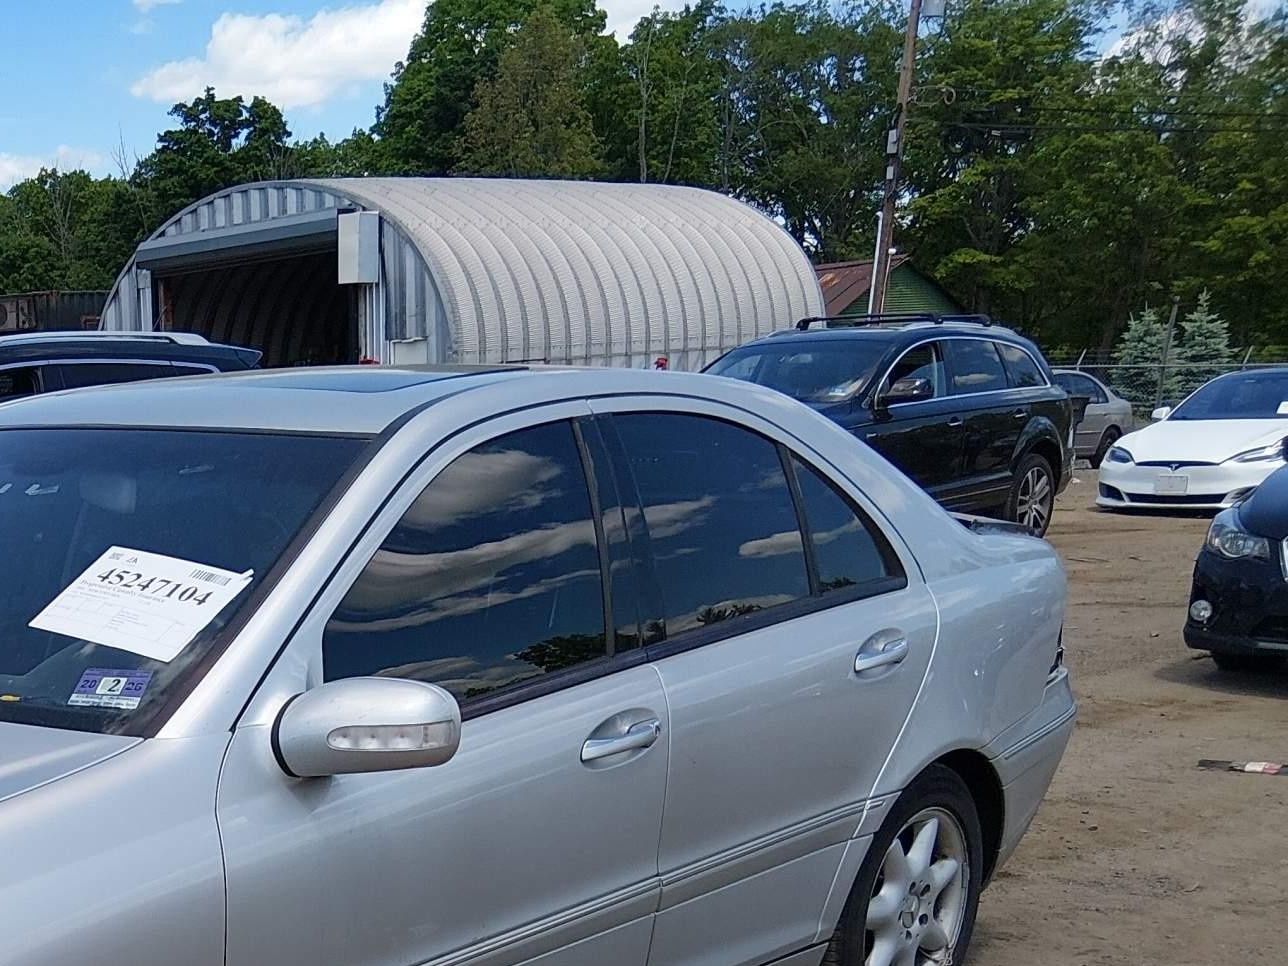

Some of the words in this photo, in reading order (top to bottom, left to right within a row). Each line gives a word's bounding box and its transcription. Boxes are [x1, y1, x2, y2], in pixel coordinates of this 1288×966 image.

[97, 568, 213, 606] 45247104
[81, 679, 97, 689] 20
[107, 678, 121, 692] 2
[125, 682, 144, 691] 26
